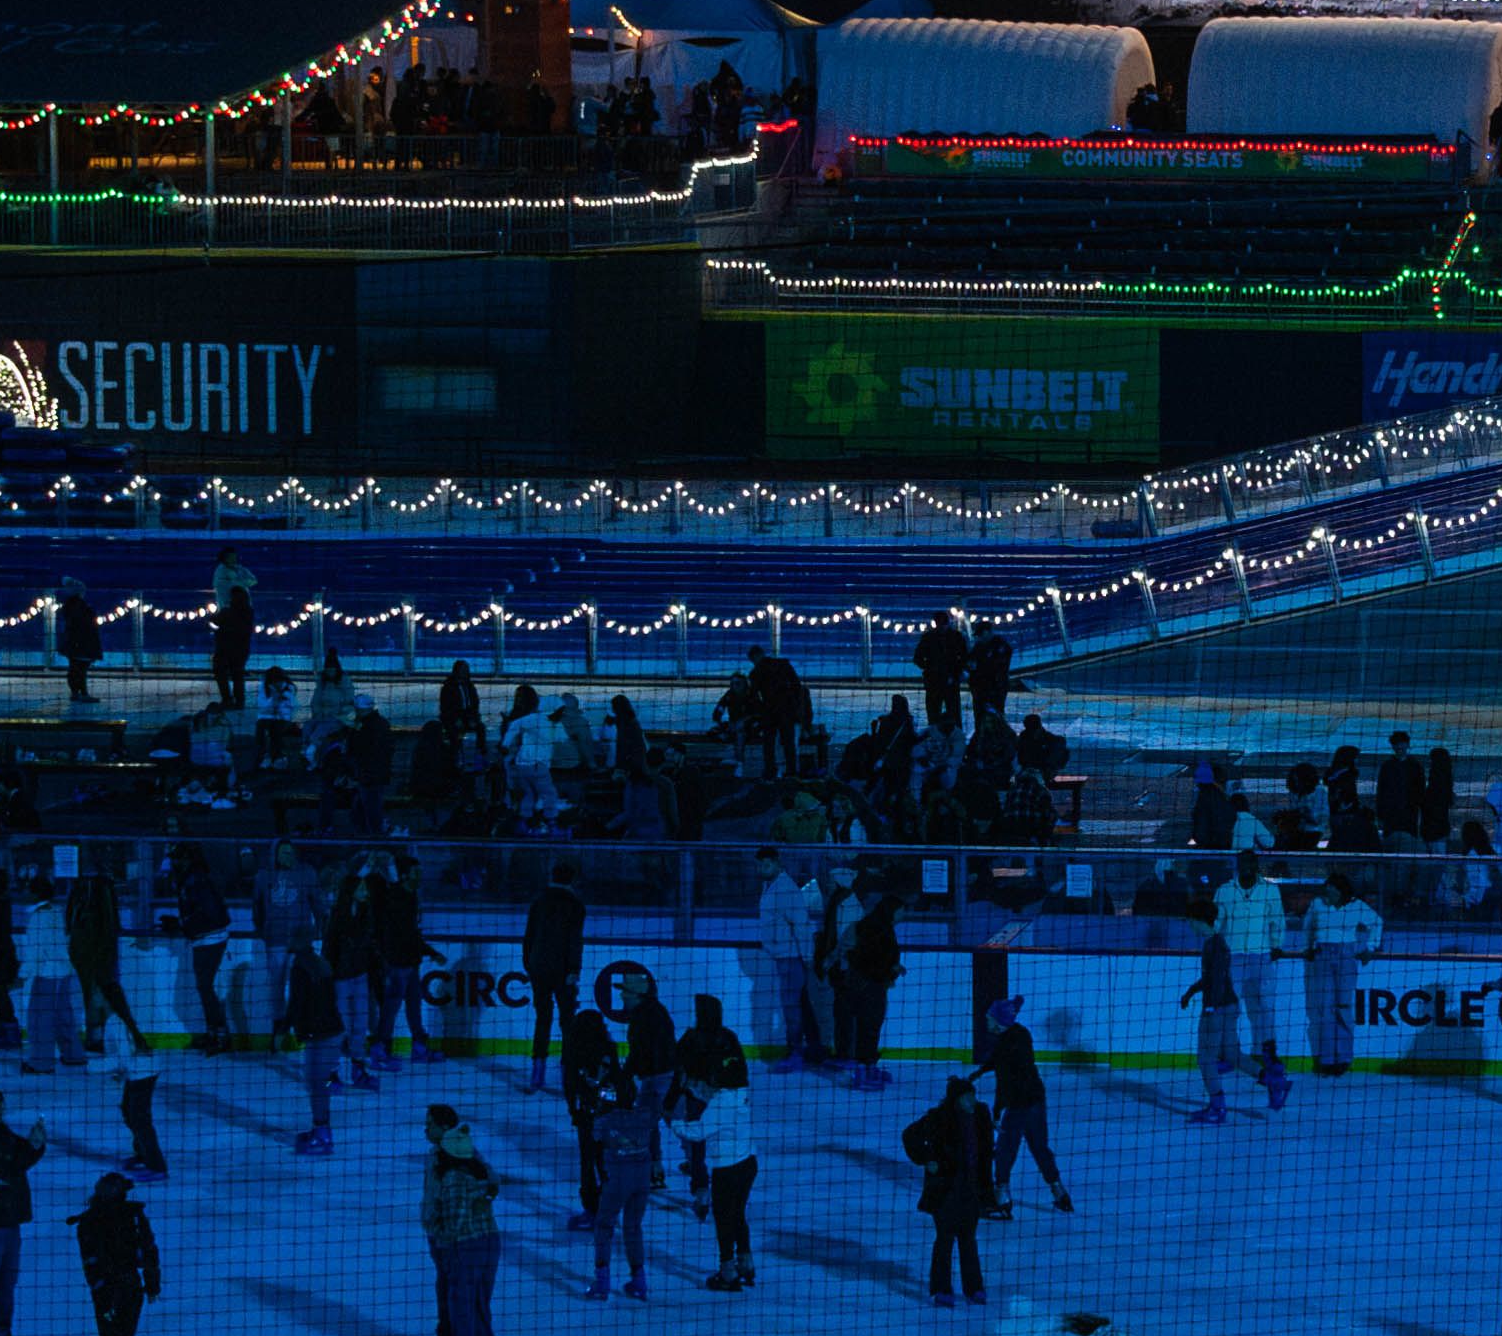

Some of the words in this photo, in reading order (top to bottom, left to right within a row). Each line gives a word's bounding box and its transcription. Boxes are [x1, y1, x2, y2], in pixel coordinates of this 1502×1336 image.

[1061, 149, 1180, 168] COMMUNITY
[1181, 150, 1244, 169] SEATS
[58, 340, 323, 434] SECURITY
[900, 367, 1129, 412] SUNBELT
[933, 413, 1093, 432] RENTALS
[421, 970, 530, 1008] CIRC
[1355, 988, 1485, 1027] IRCLE
